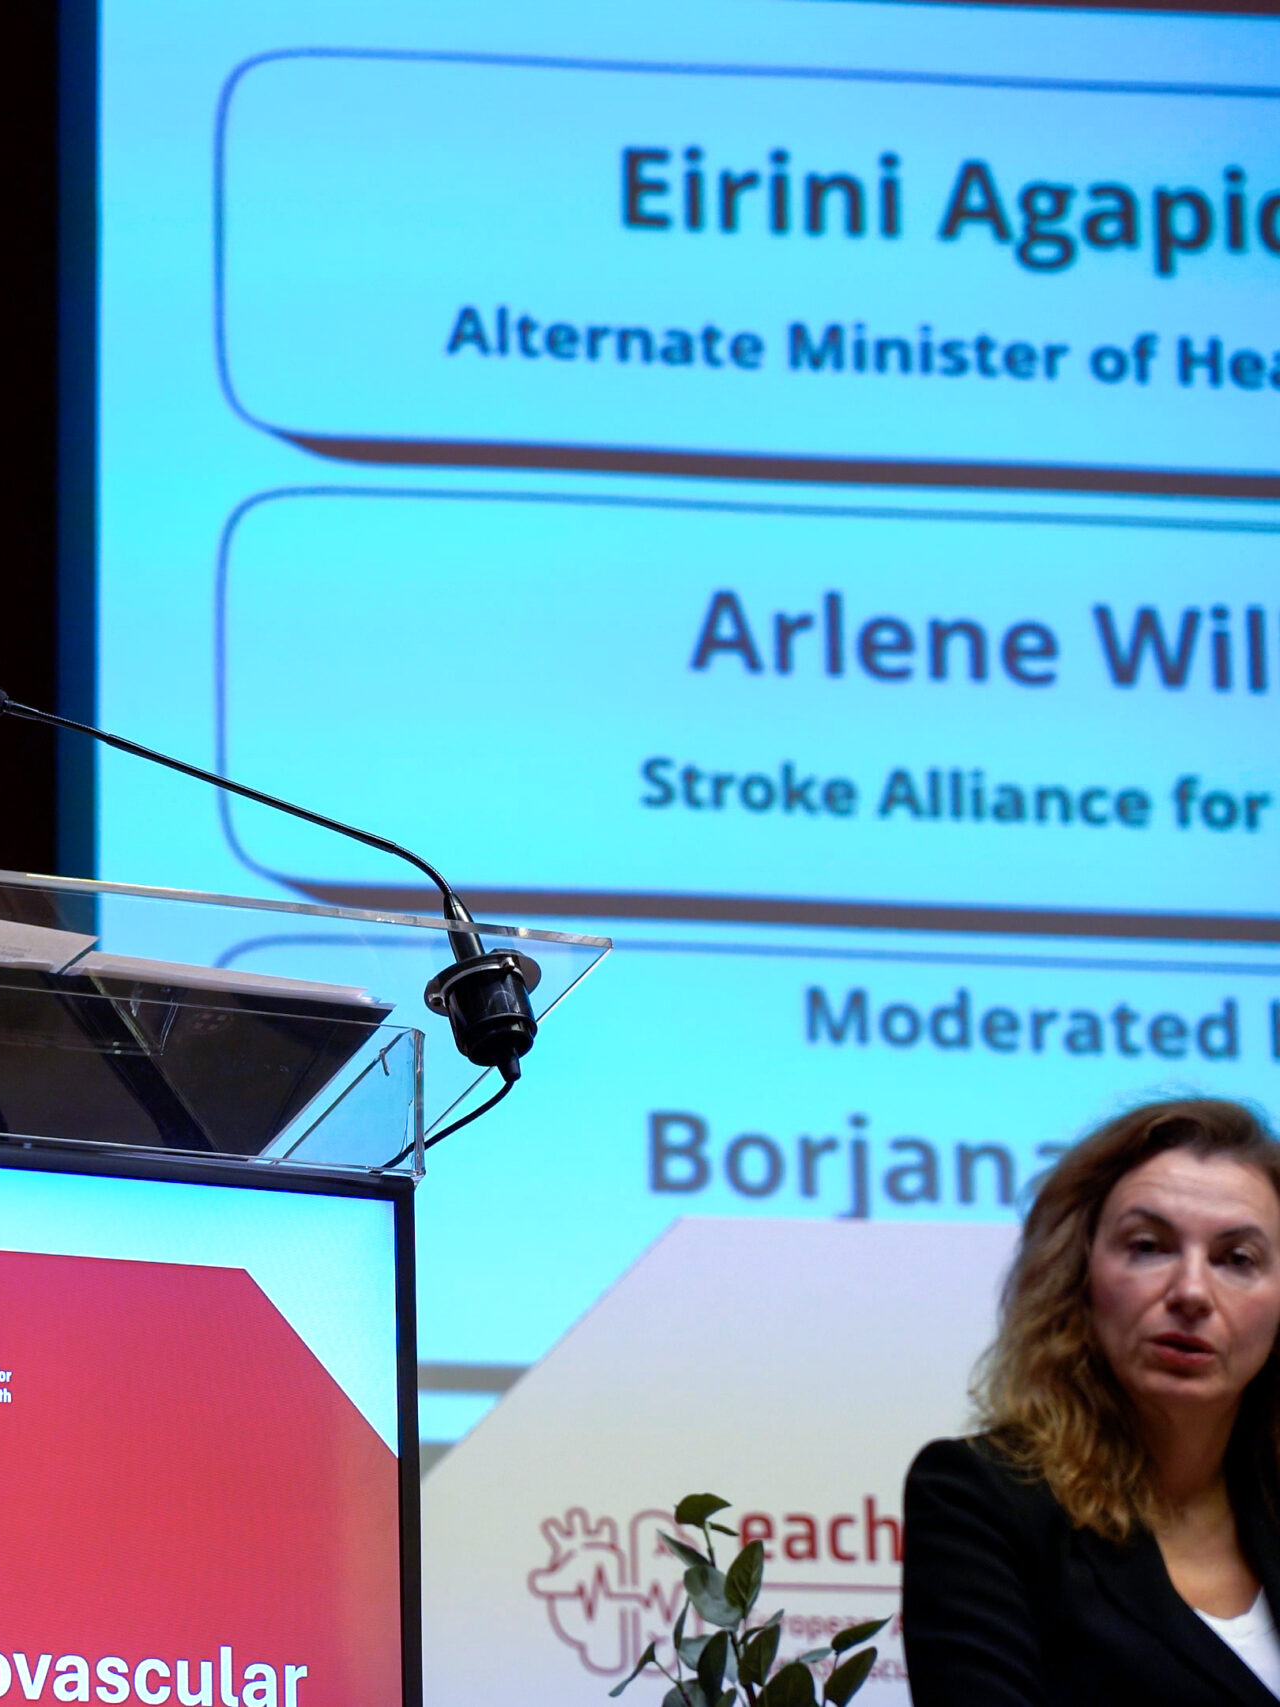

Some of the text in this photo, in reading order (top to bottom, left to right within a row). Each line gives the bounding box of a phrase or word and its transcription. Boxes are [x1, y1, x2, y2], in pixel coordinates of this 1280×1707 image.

[620, 146, 901, 239] Eirini
[446, 305, 765, 371] Alternate
[786, 321, 1070, 382] Minister
[1089, 331, 1159, 386] of
[689, 590, 1280, 696] Arlene Wil
[639, 756, 1273, 835] Stroke Alliance for
[804, 985, 1240, 1063] Moderated
[646, 1110, 1072, 1220] Borjan
[740, 1495, 902, 1563] each
